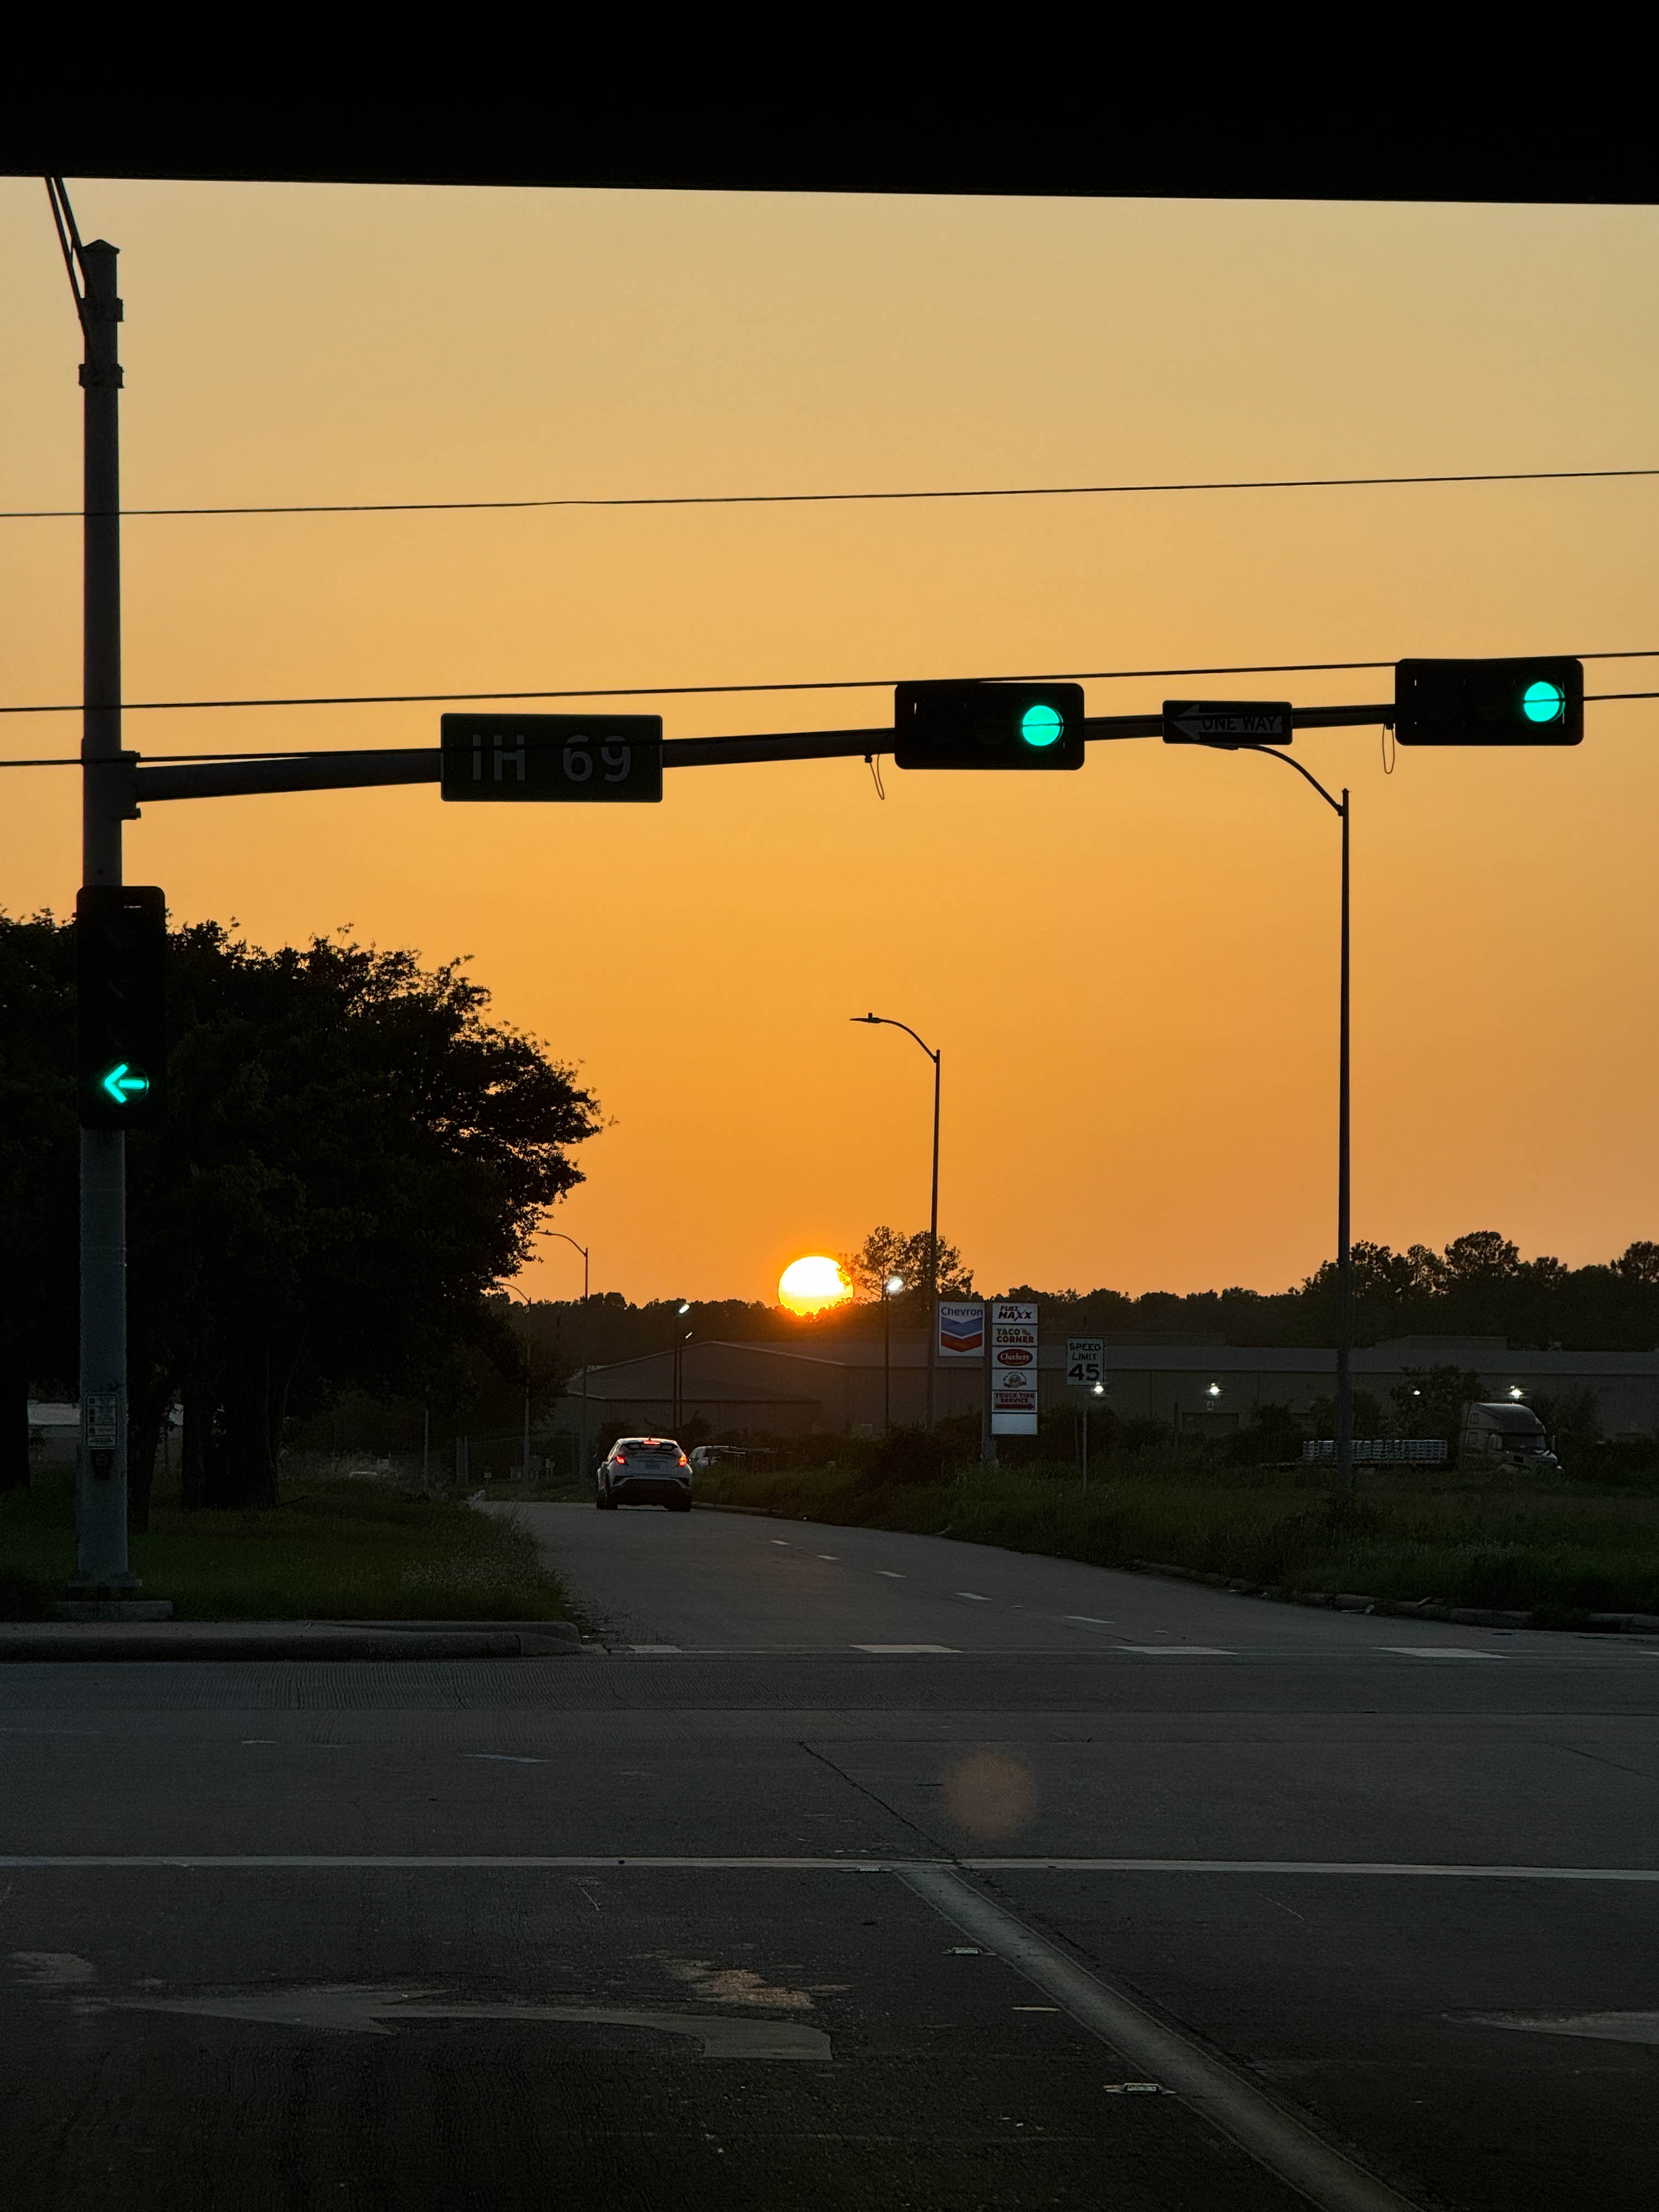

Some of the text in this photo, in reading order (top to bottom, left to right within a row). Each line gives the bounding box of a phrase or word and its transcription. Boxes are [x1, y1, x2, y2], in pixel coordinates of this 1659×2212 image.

[1202, 715, 1276, 731] ONE WAY
[562, 734, 631, 782] 69
[941, 1306, 983, 1317] Chevron
[1069, 1342, 1101, 1351] SPEED
[1000, 1352, 1030, 1361] Checkers
[1068, 1363, 1100, 1381] 45
